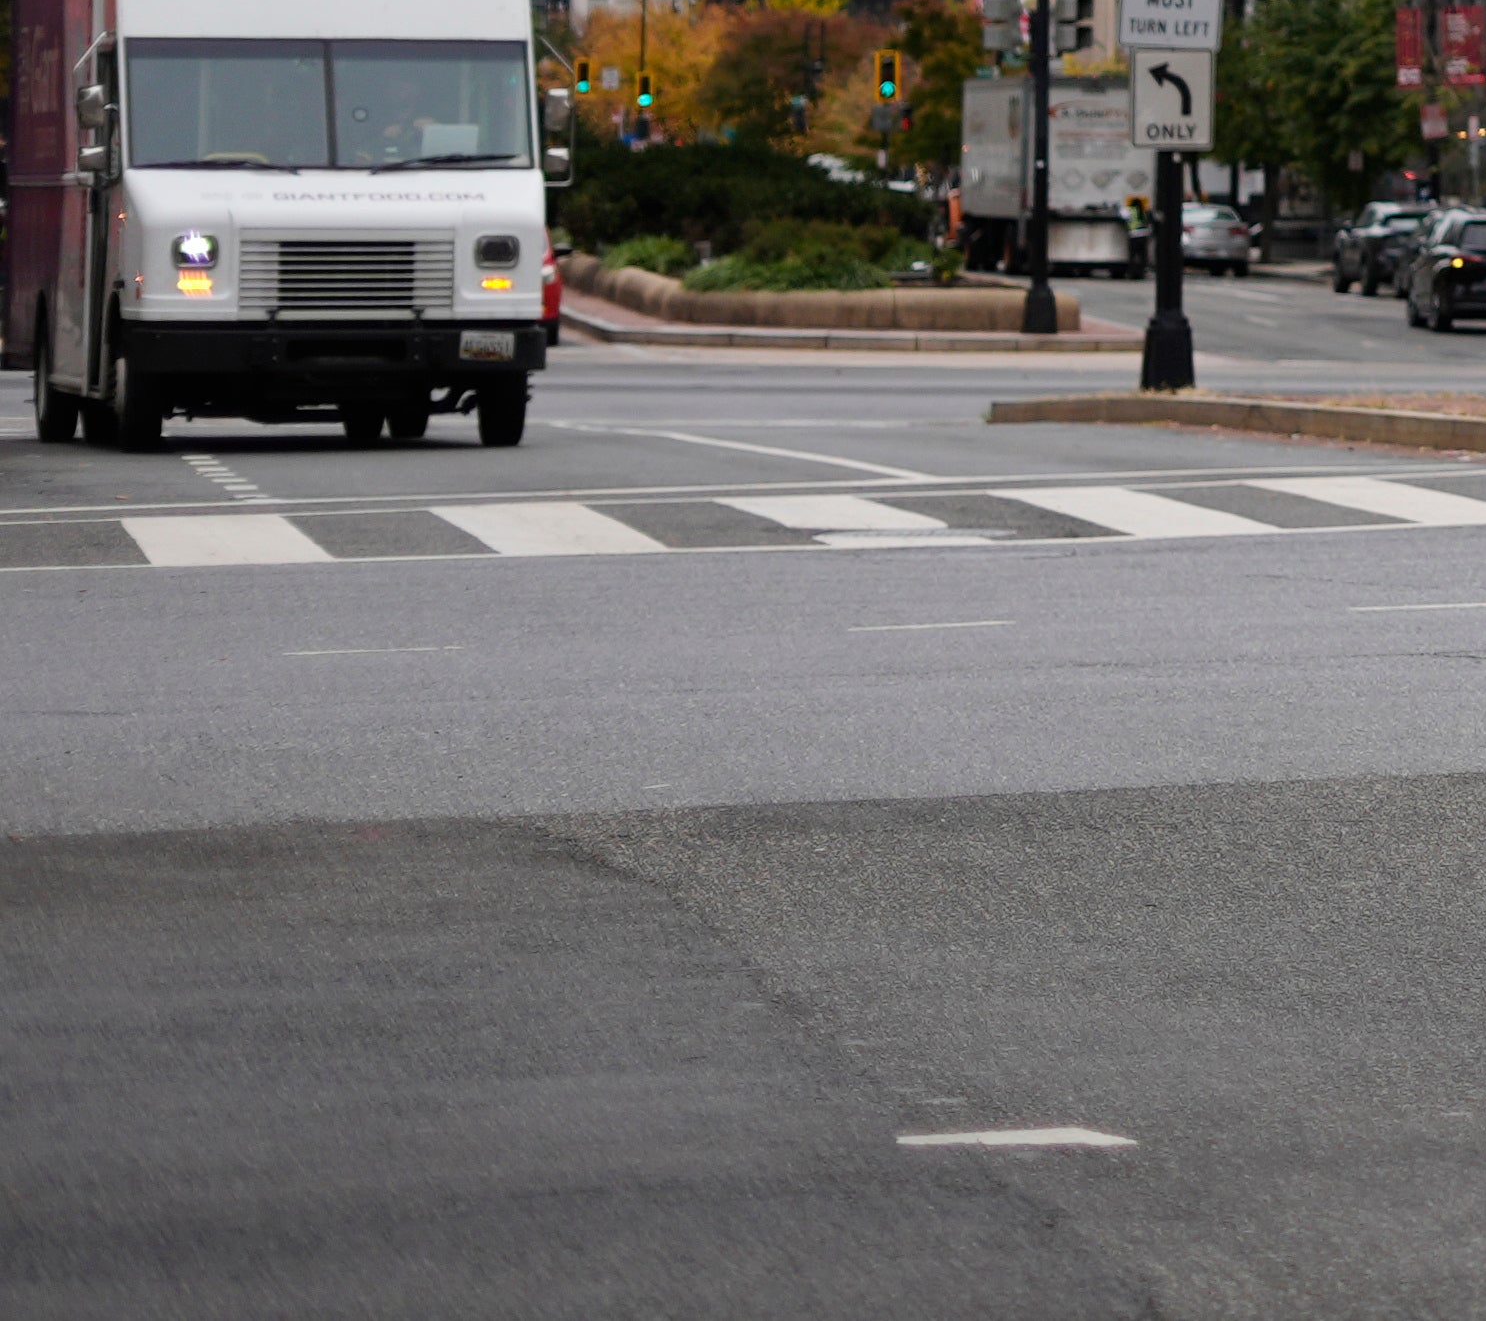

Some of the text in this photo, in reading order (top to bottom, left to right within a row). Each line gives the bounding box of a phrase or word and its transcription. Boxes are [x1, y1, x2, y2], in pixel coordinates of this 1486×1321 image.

[1129, 17, 1210, 37] TURN LEFT
[1146, 122, 1198, 141] ONLY
[272, 191, 487, 202] GIANTFOOD.COM
